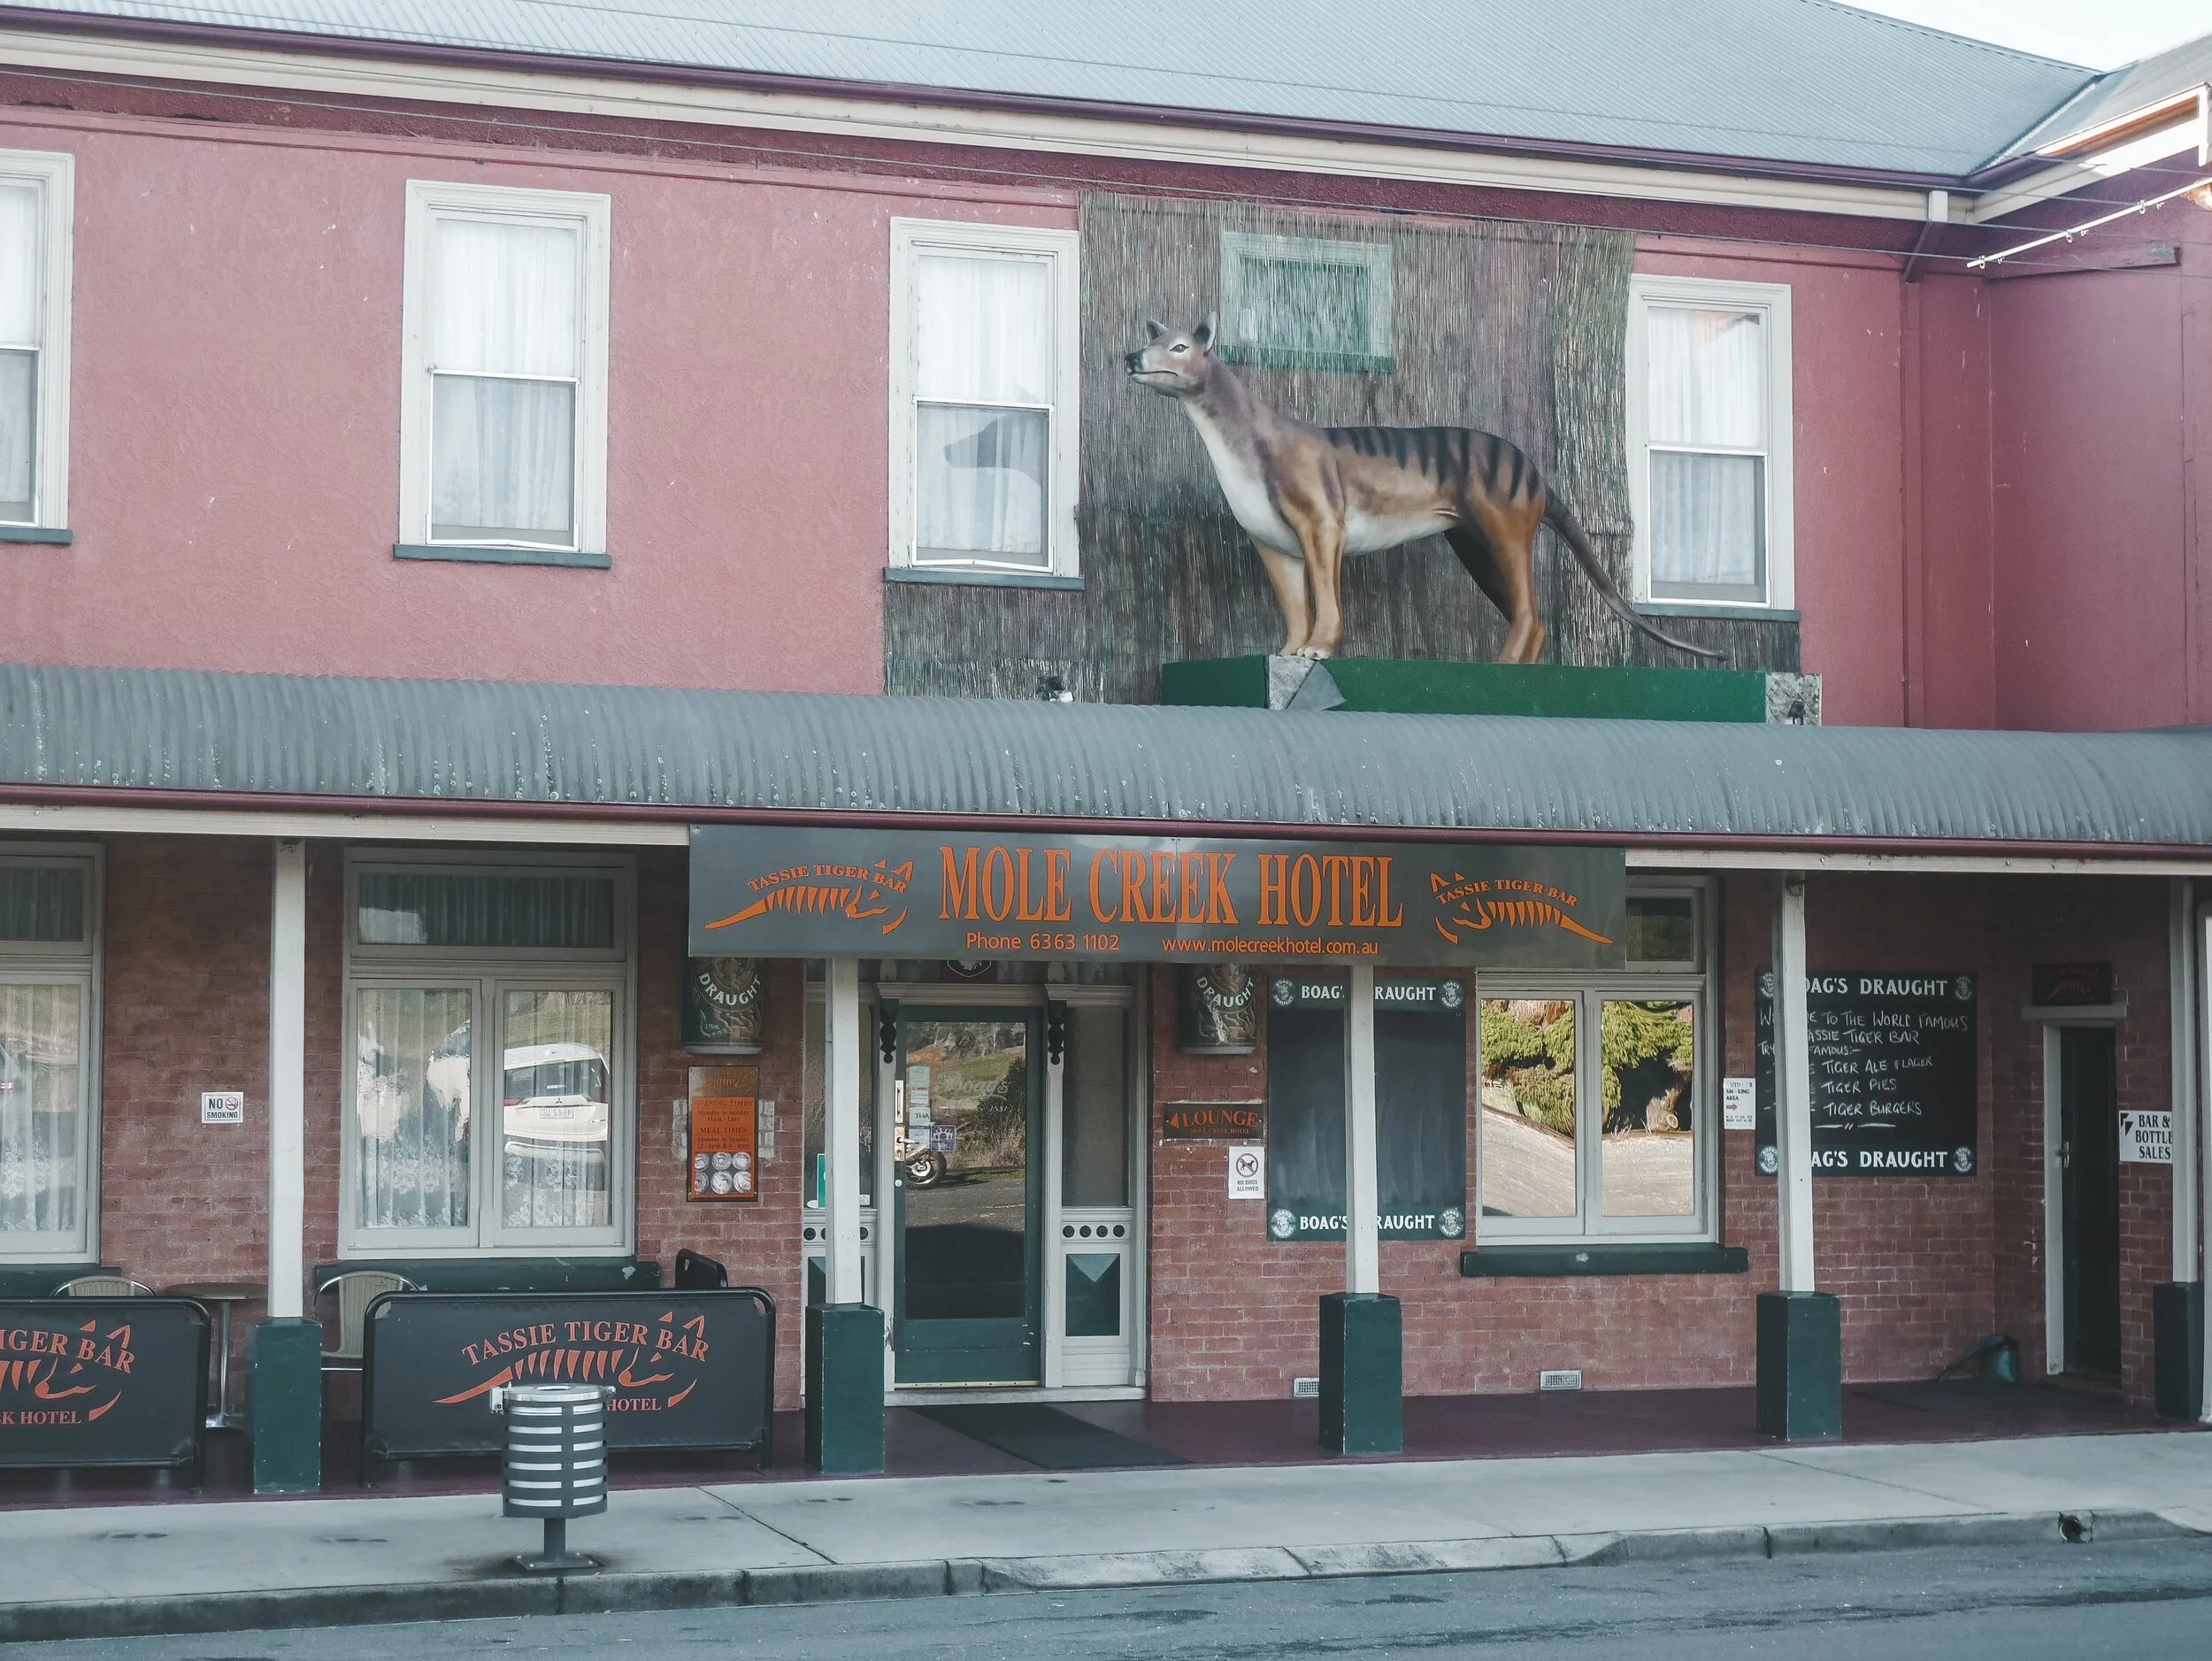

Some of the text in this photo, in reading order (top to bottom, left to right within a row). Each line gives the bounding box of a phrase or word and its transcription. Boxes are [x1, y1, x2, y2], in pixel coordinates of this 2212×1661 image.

[748, 863, 909, 894] TASSIE TIGER BAR
[938, 846, 1404, 927] MOLE CREEK HOTEL
[1436, 880, 1579, 908] TASSIE TIGER BAR
[965, 931, 1120, 951] Phone 6363 1102
[1162, 936, 1379, 956] www.molecreekhotel.com.au
[699, 973, 761, 1006] DRAUGHT
[1196, 976, 1255, 1008] DRAUGHT
[1301, 985, 1437, 1001] BOAG' RAUGHT
[1860, 979, 1948, 996] DRAUGHT
[1821, 1011, 1839, 1026] TO
[1840, 1010, 1865, 1027] THE
[1872, 1010, 1911, 1028] WORLD
[1918, 1012, 1969, 1032] FAMOUS
[1808, 1028, 1920, 1045] ASSIE TIGER BAR
[1821, 1061, 1859, 1074] TIGER
[1864, 1058, 1888, 1073] ALE
[1901, 1057, 1933, 1069] LAGER
[1820, 1080, 1862, 1095] TIGER
[1869, 1078, 1897, 1091] PIES
[209, 1098, 223, 1110] NO
[1823, 1103, 1863, 1117] TIGER
[1181, 1110, 1258, 1127] LOUNGE
[2139, 1114, 2170, 1128] BAR &
[2135, 1130, 2173, 1144] BOTTLE
[1810, 1150, 1948, 1168] AG'S DRAUGHT
[2139, 1145, 2171, 1160] SALES
[1300, 1214, 1435, 1230] BOAG'S RAUGHT
[0, 1329, 135, 1374] IGER BAR
[461, 1320, 710, 1367] TASSIE TIGER BAR
[607, 1398, 662, 1411] HOTEL
[19, 1411, 82, 1425] HOTEL
